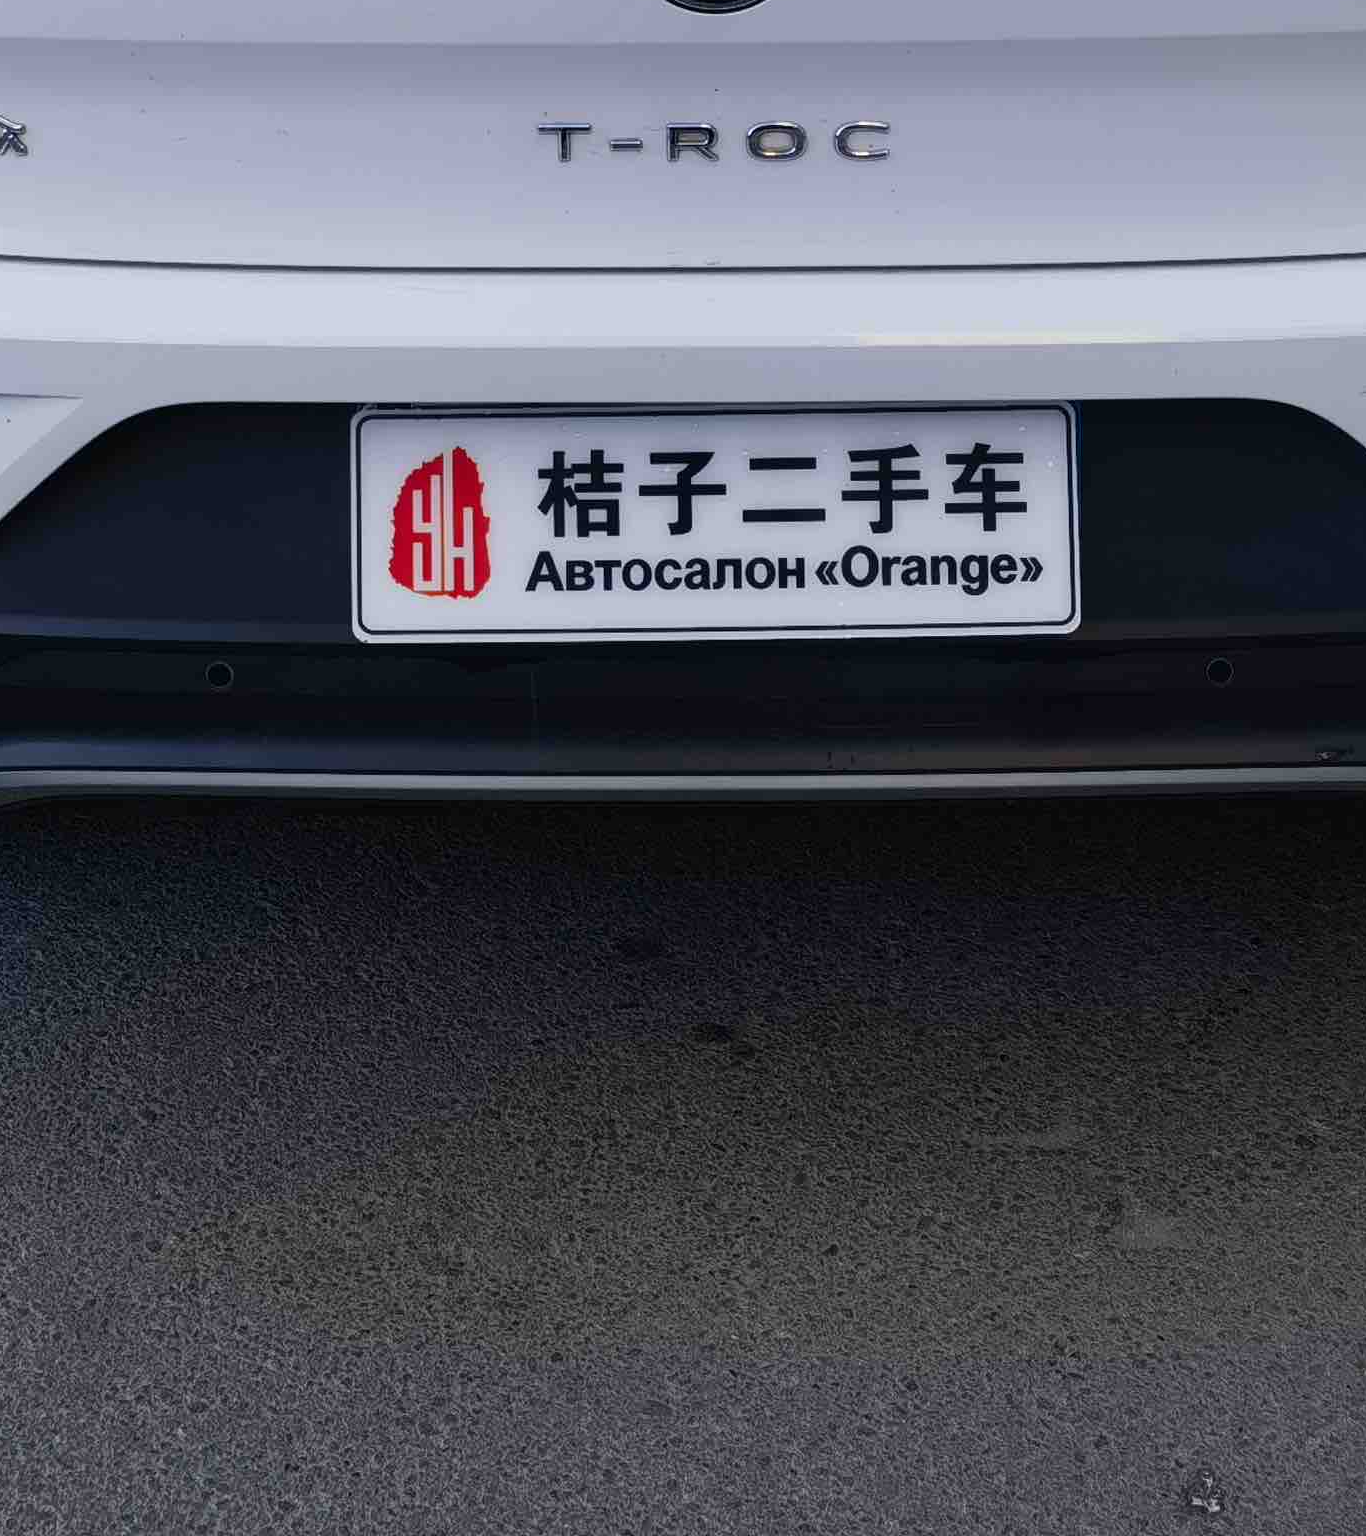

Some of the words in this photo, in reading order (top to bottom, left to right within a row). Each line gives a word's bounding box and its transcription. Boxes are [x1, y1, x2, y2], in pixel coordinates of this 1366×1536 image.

[538, 121, 892, 162] T-ROC
[537, 443, 1028, 538] 桔子二手车
[525, 551, 806, 592] Автосалон
[814, 545, 1045, 596] «Orange»
